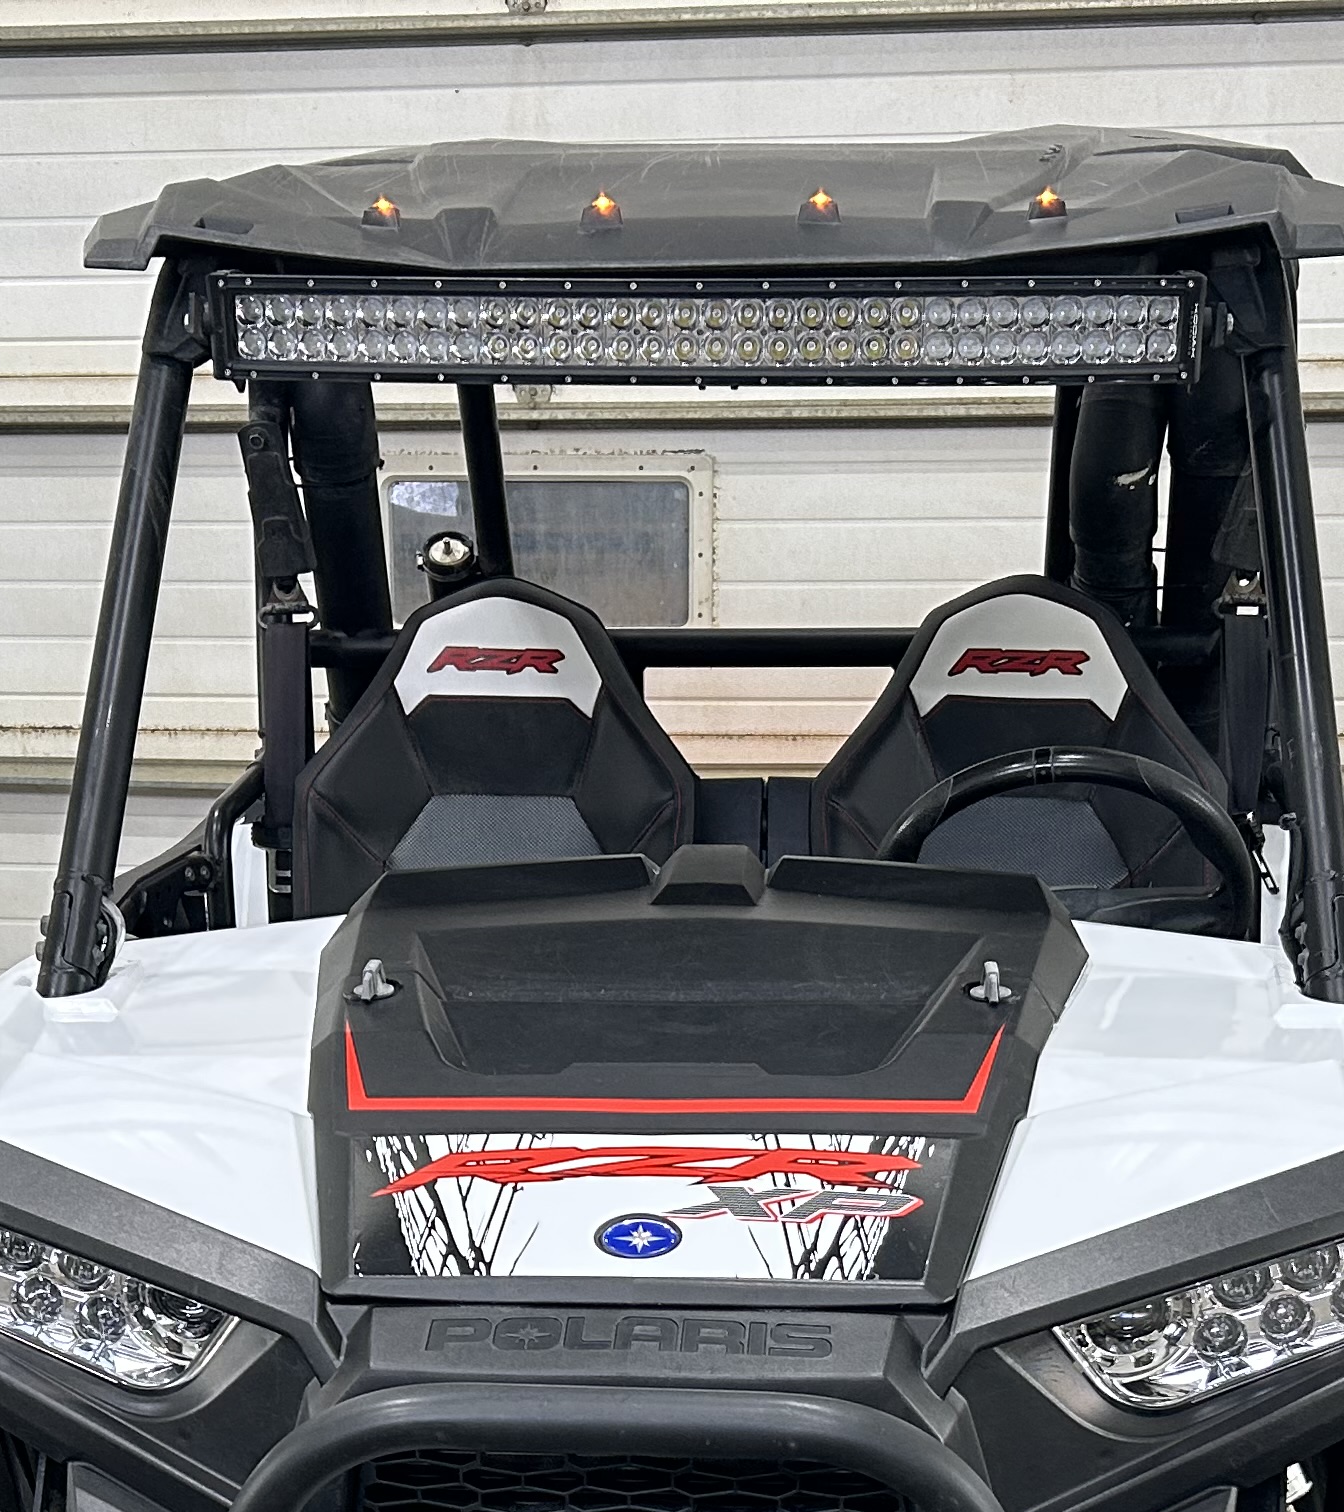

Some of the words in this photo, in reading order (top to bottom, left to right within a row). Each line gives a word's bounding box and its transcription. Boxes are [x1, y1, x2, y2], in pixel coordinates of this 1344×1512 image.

[427, 645, 565, 674] RZR
[948, 647, 1090, 677] RZR
[370, 1146, 922, 1197] RZR
[659, 1185, 923, 1222] XP
[424, 1315, 833, 1359] POLARIS
